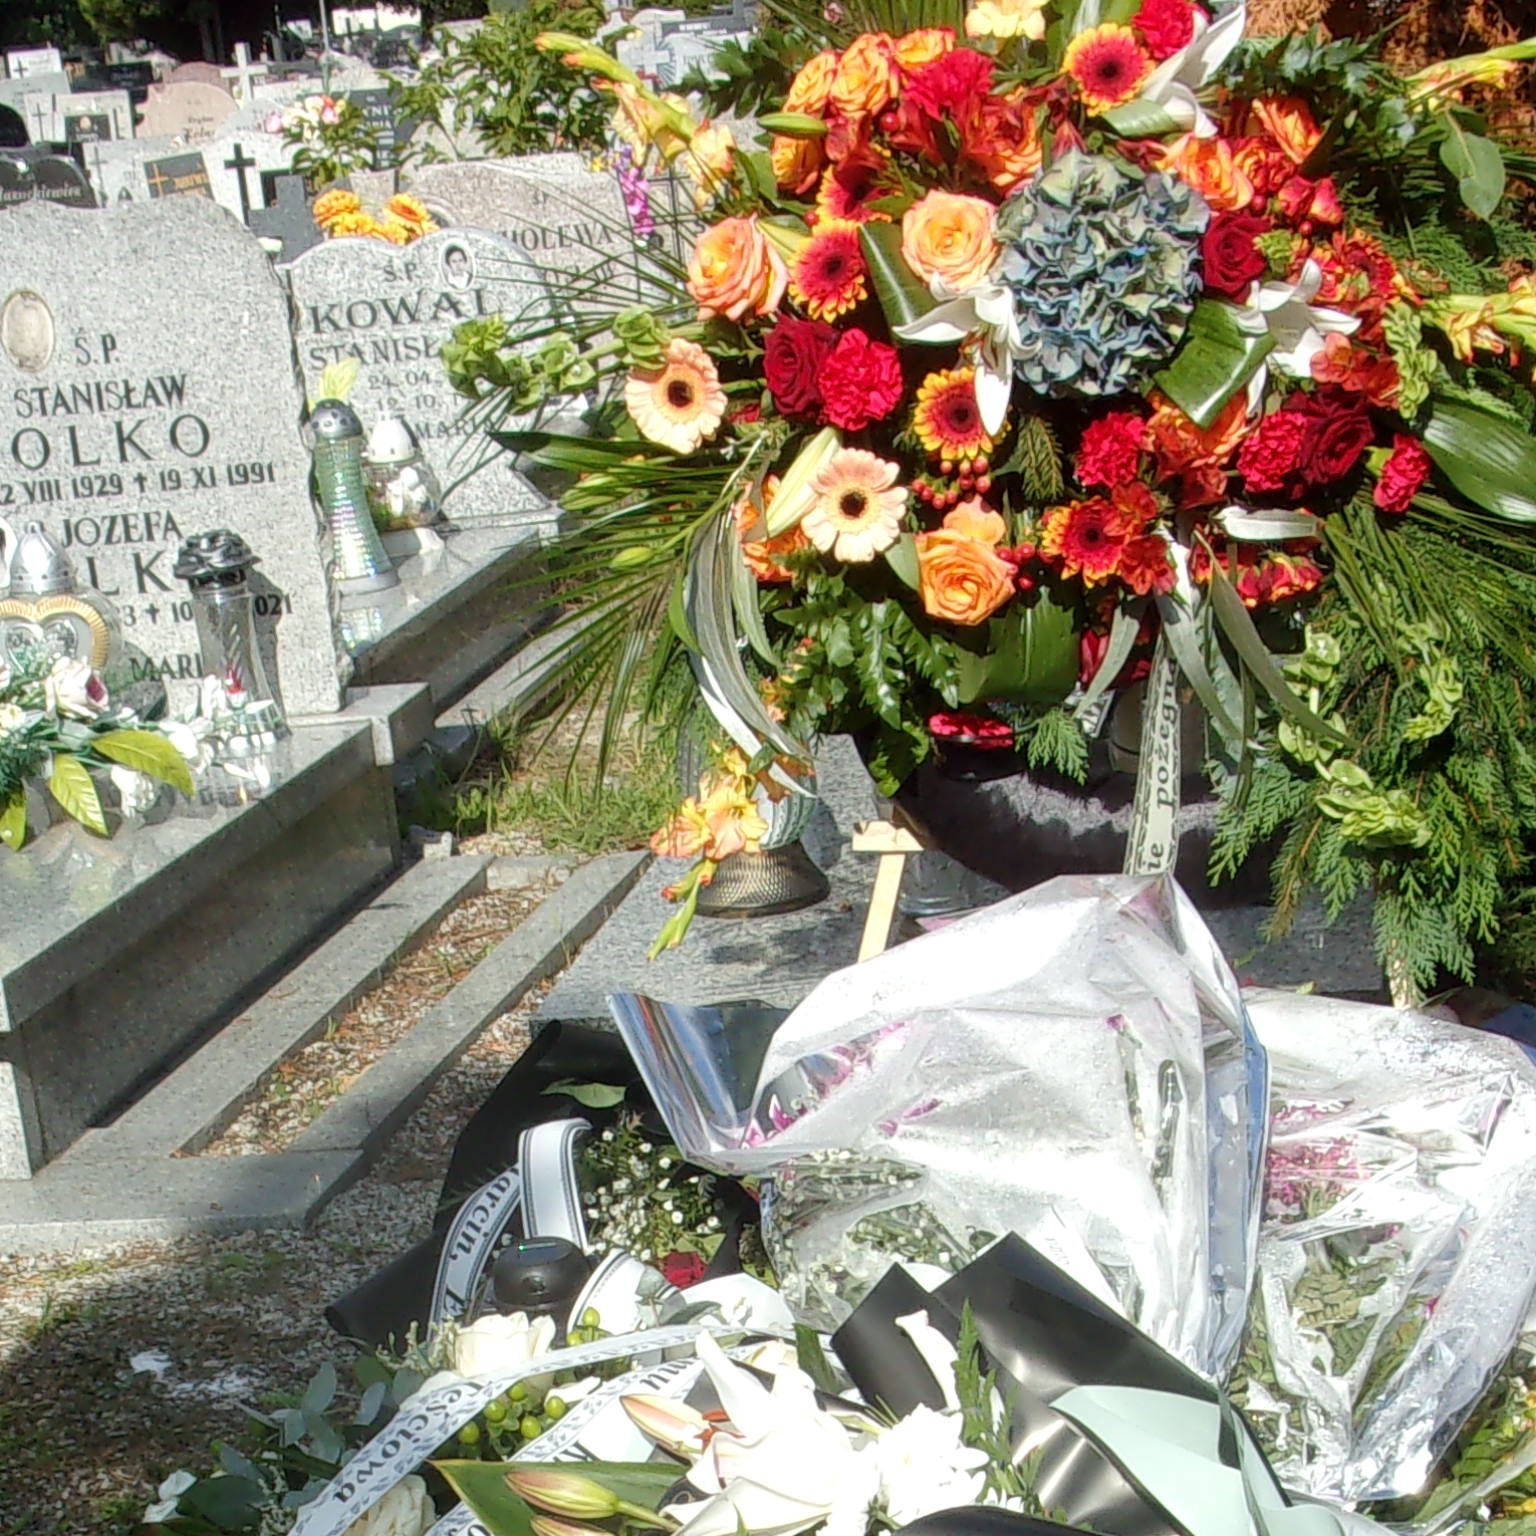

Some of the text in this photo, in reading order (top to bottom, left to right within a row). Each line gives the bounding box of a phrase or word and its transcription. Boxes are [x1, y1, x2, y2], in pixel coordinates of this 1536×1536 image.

[502, 223, 614, 251] HOLEWA
[309, 335, 441, 371] STANISŁ
[14, 373, 187, 419] STANISŁAW
[11, 414, 210, 471] OLKO
[22, 478, 62, 503] VIII
[72, 472, 124, 498] 1929
[159, 468, 182, 492] 19
[192, 465, 218, 489] XI
[227, 461, 276, 486] 1991
[128, 653, 205, 682] MARI
[450, 1170, 517, 1260] arcin,
